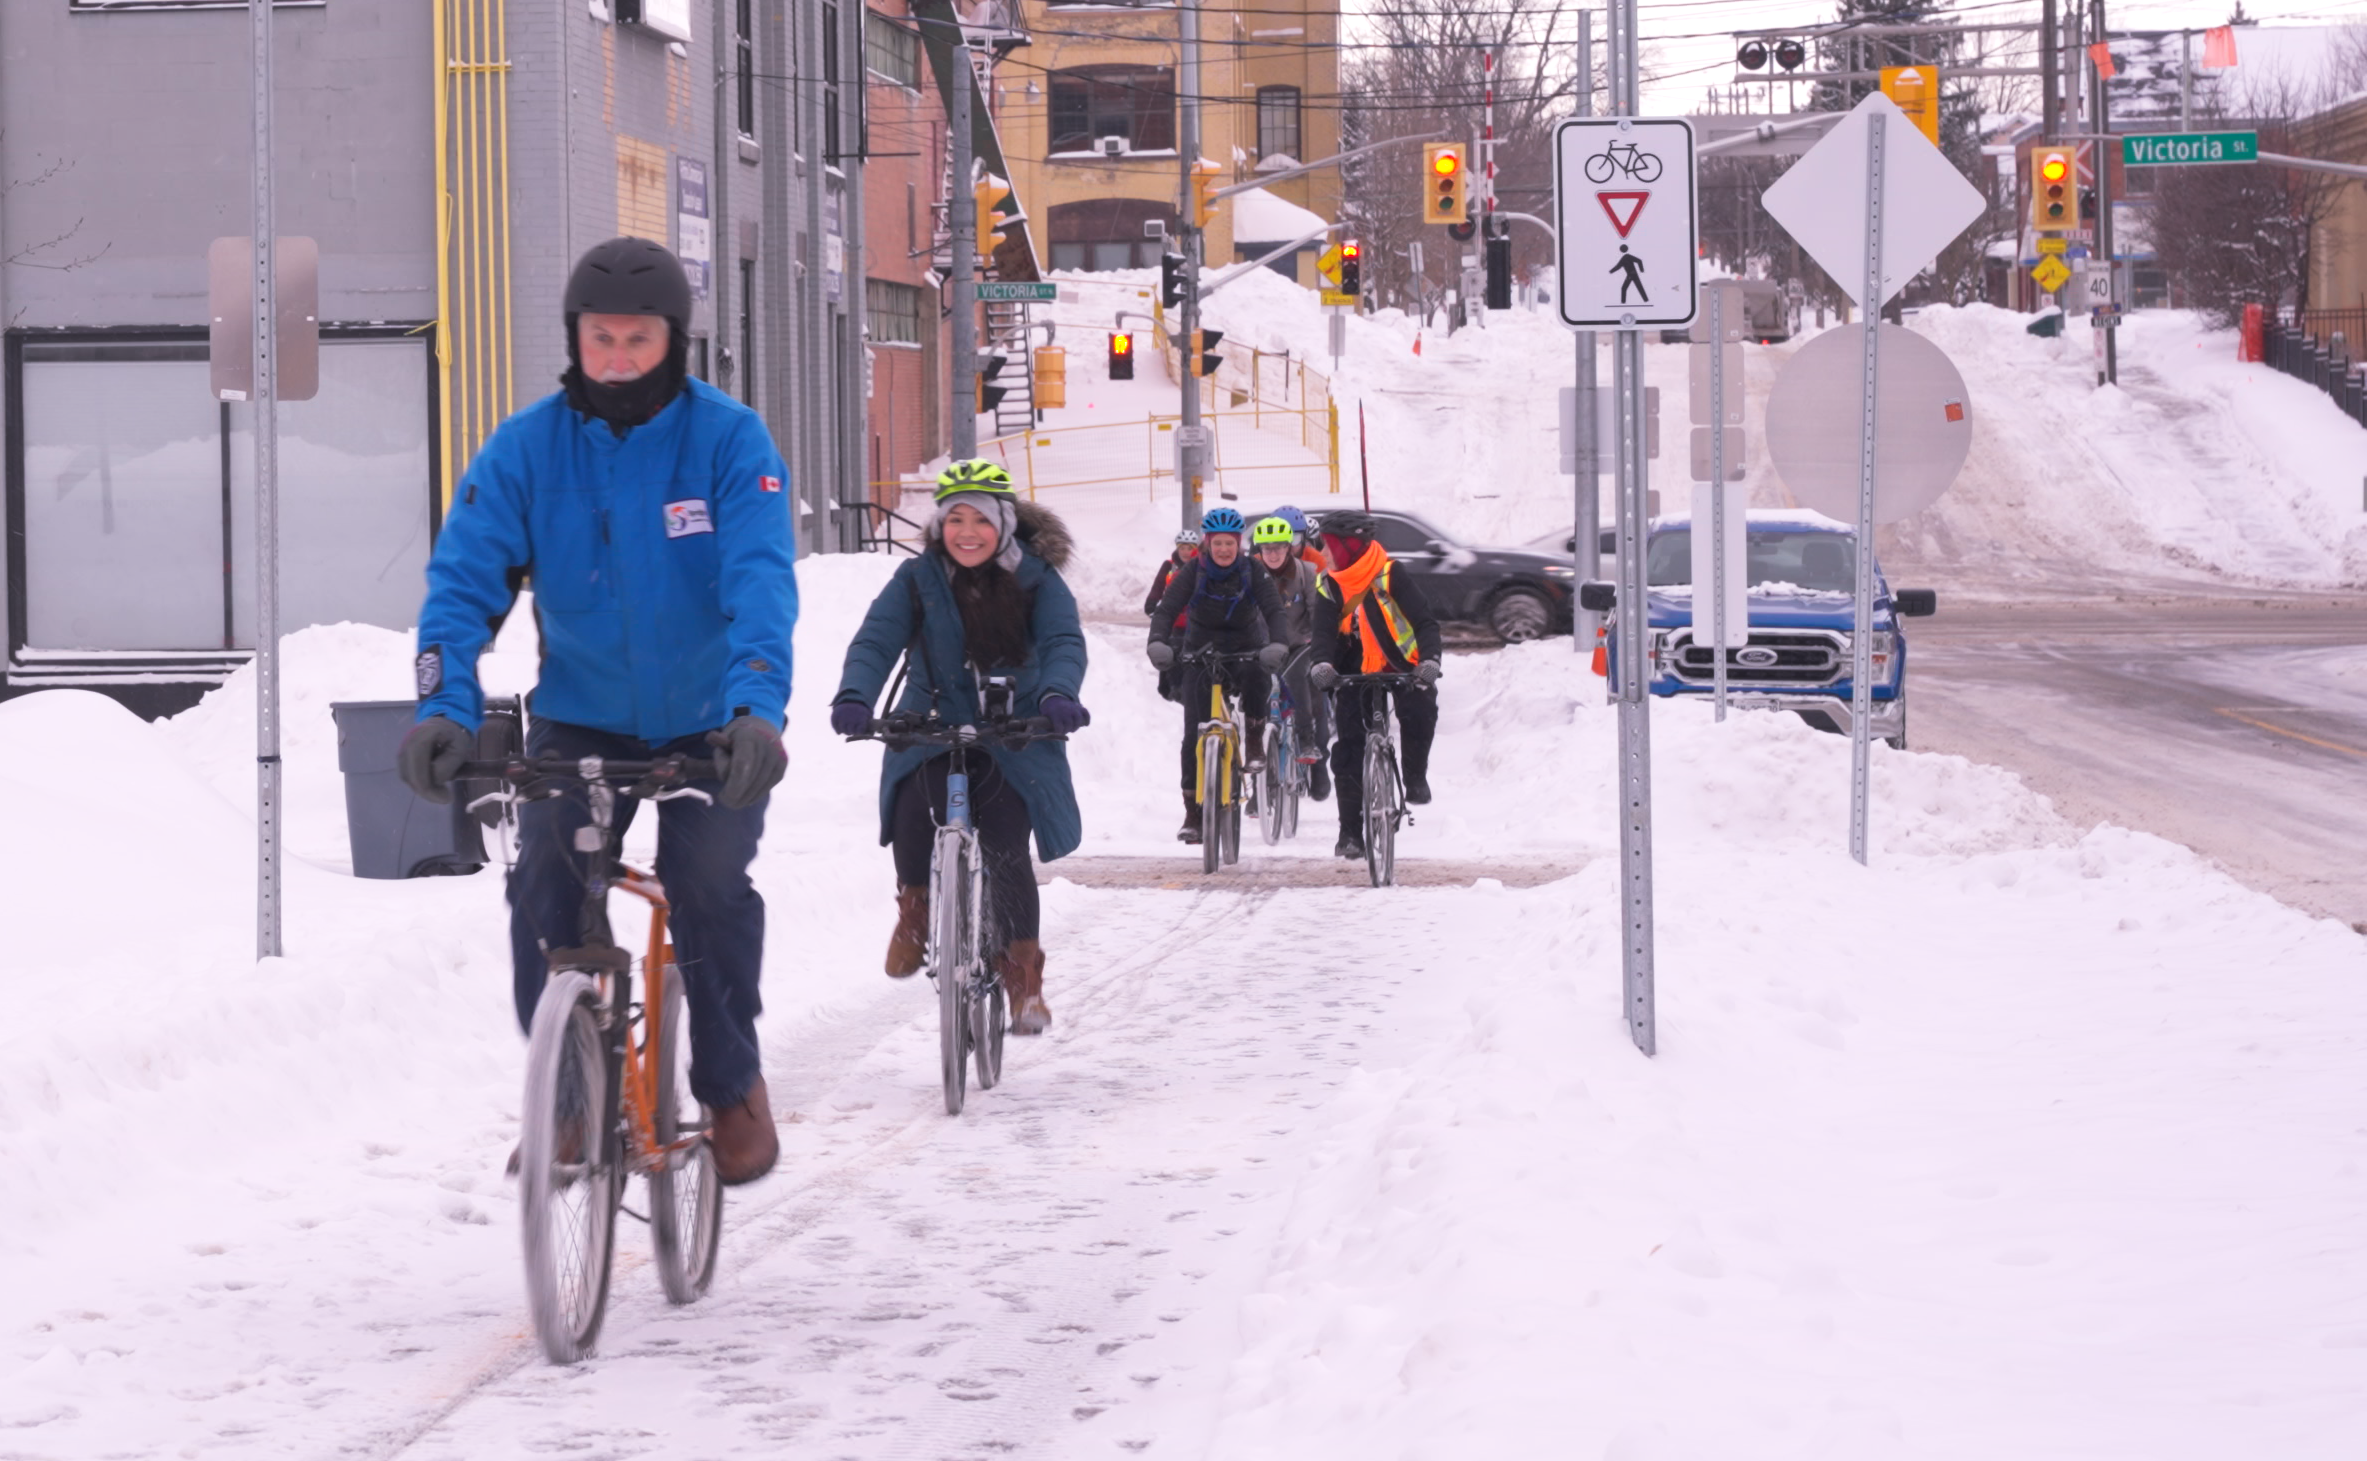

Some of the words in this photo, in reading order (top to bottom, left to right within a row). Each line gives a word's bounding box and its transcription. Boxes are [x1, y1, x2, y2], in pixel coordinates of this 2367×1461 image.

[2131, 136, 2222, 161] Victoria
[2233, 140, 2248, 152] St.
[981, 285, 1037, 297] VICTORIA
[2090, 278, 2108, 296] 40
[1747, 652, 1767, 661] Ford
